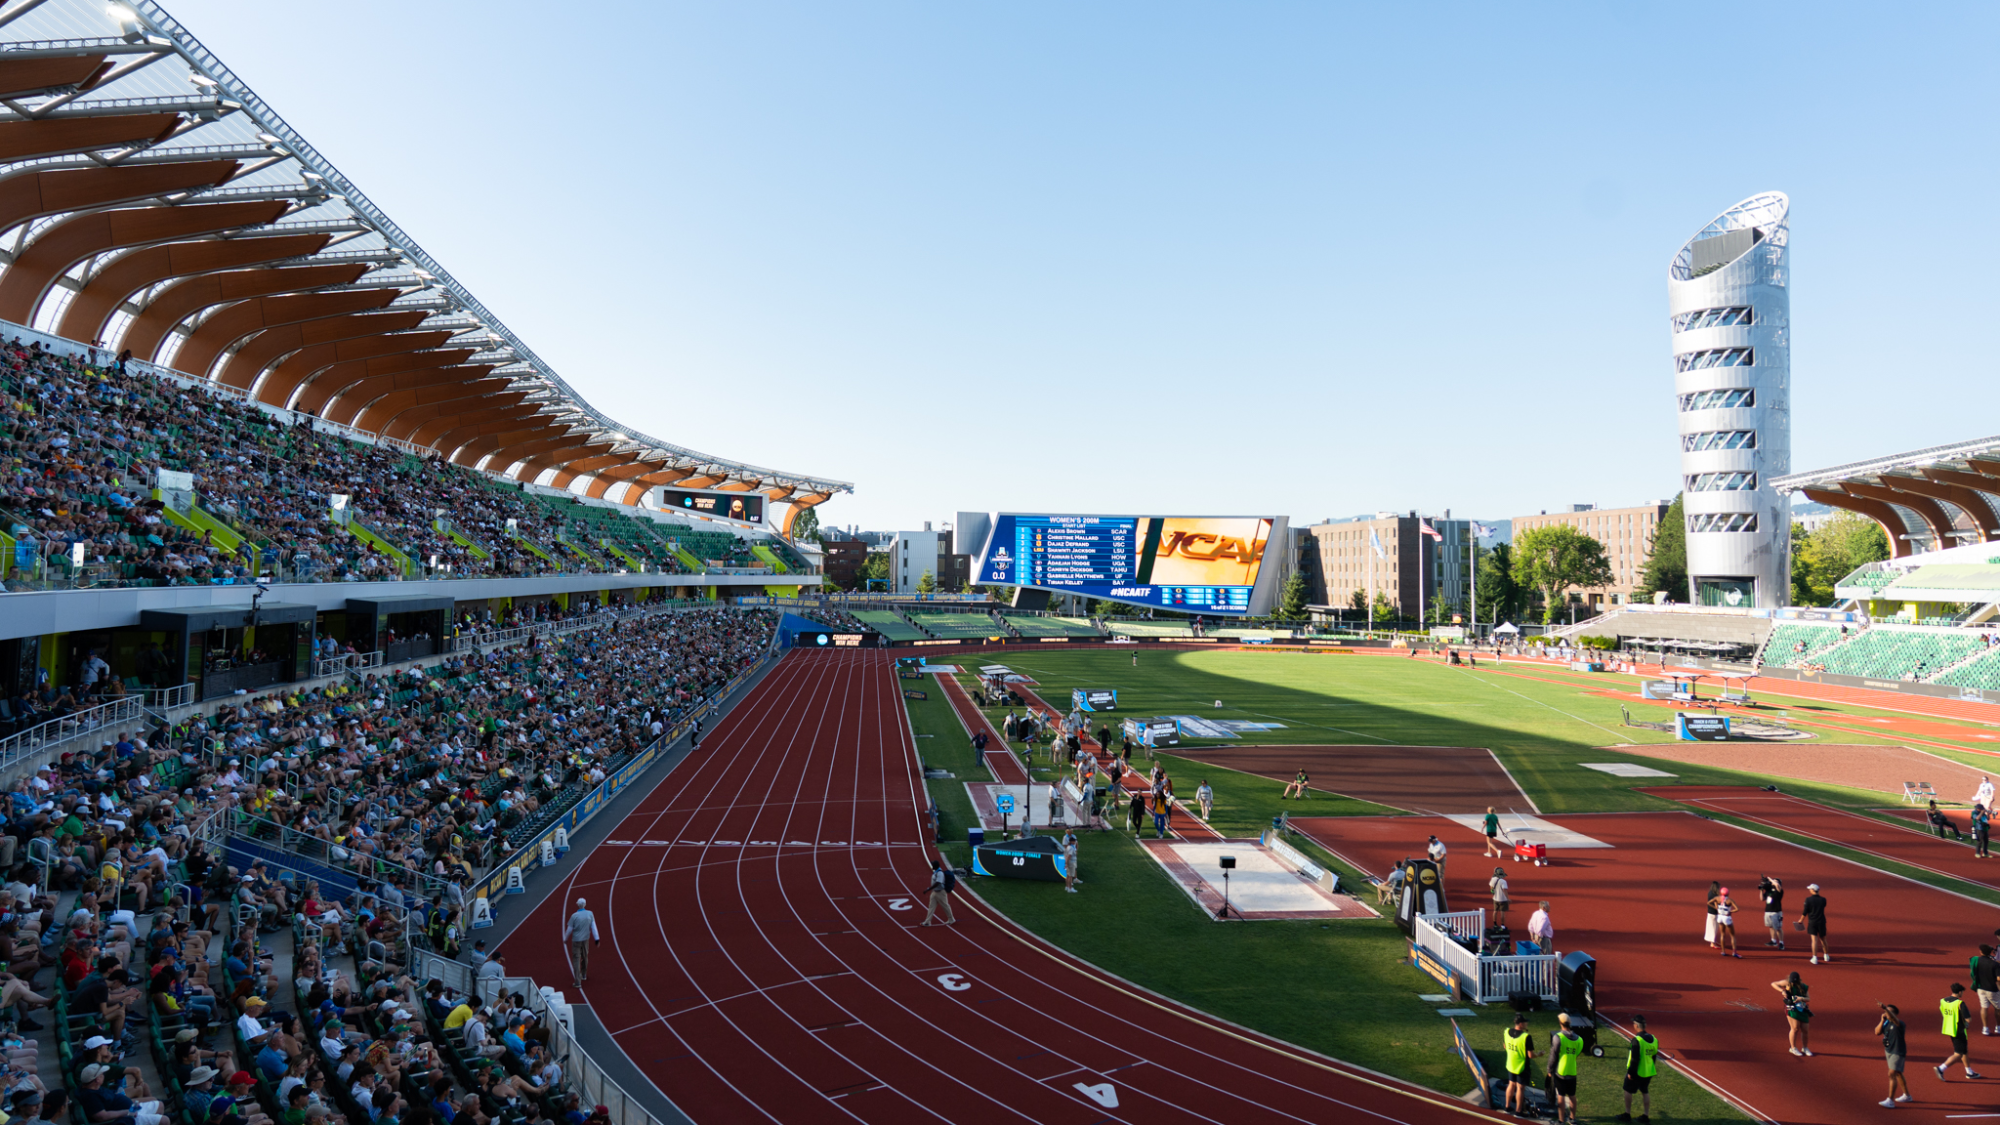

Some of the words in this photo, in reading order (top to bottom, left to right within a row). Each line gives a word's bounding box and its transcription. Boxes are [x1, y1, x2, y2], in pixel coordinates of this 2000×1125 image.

[1111, 588, 1151, 597] #NCAATF
[1876, 600, 1898, 616] 103
[1918, 602, 1942, 618] 104
[560, 836, 563, 846] 1
[547, 849, 553, 859] 2
[1012, 857, 1025, 866] 0.0
[511, 876, 519, 887] 3
[888, 898, 912, 911] 2
[478, 908, 487, 920] 4
[937, 974, 971, 991] 3
[1072, 1082, 1119, 1108] 4
